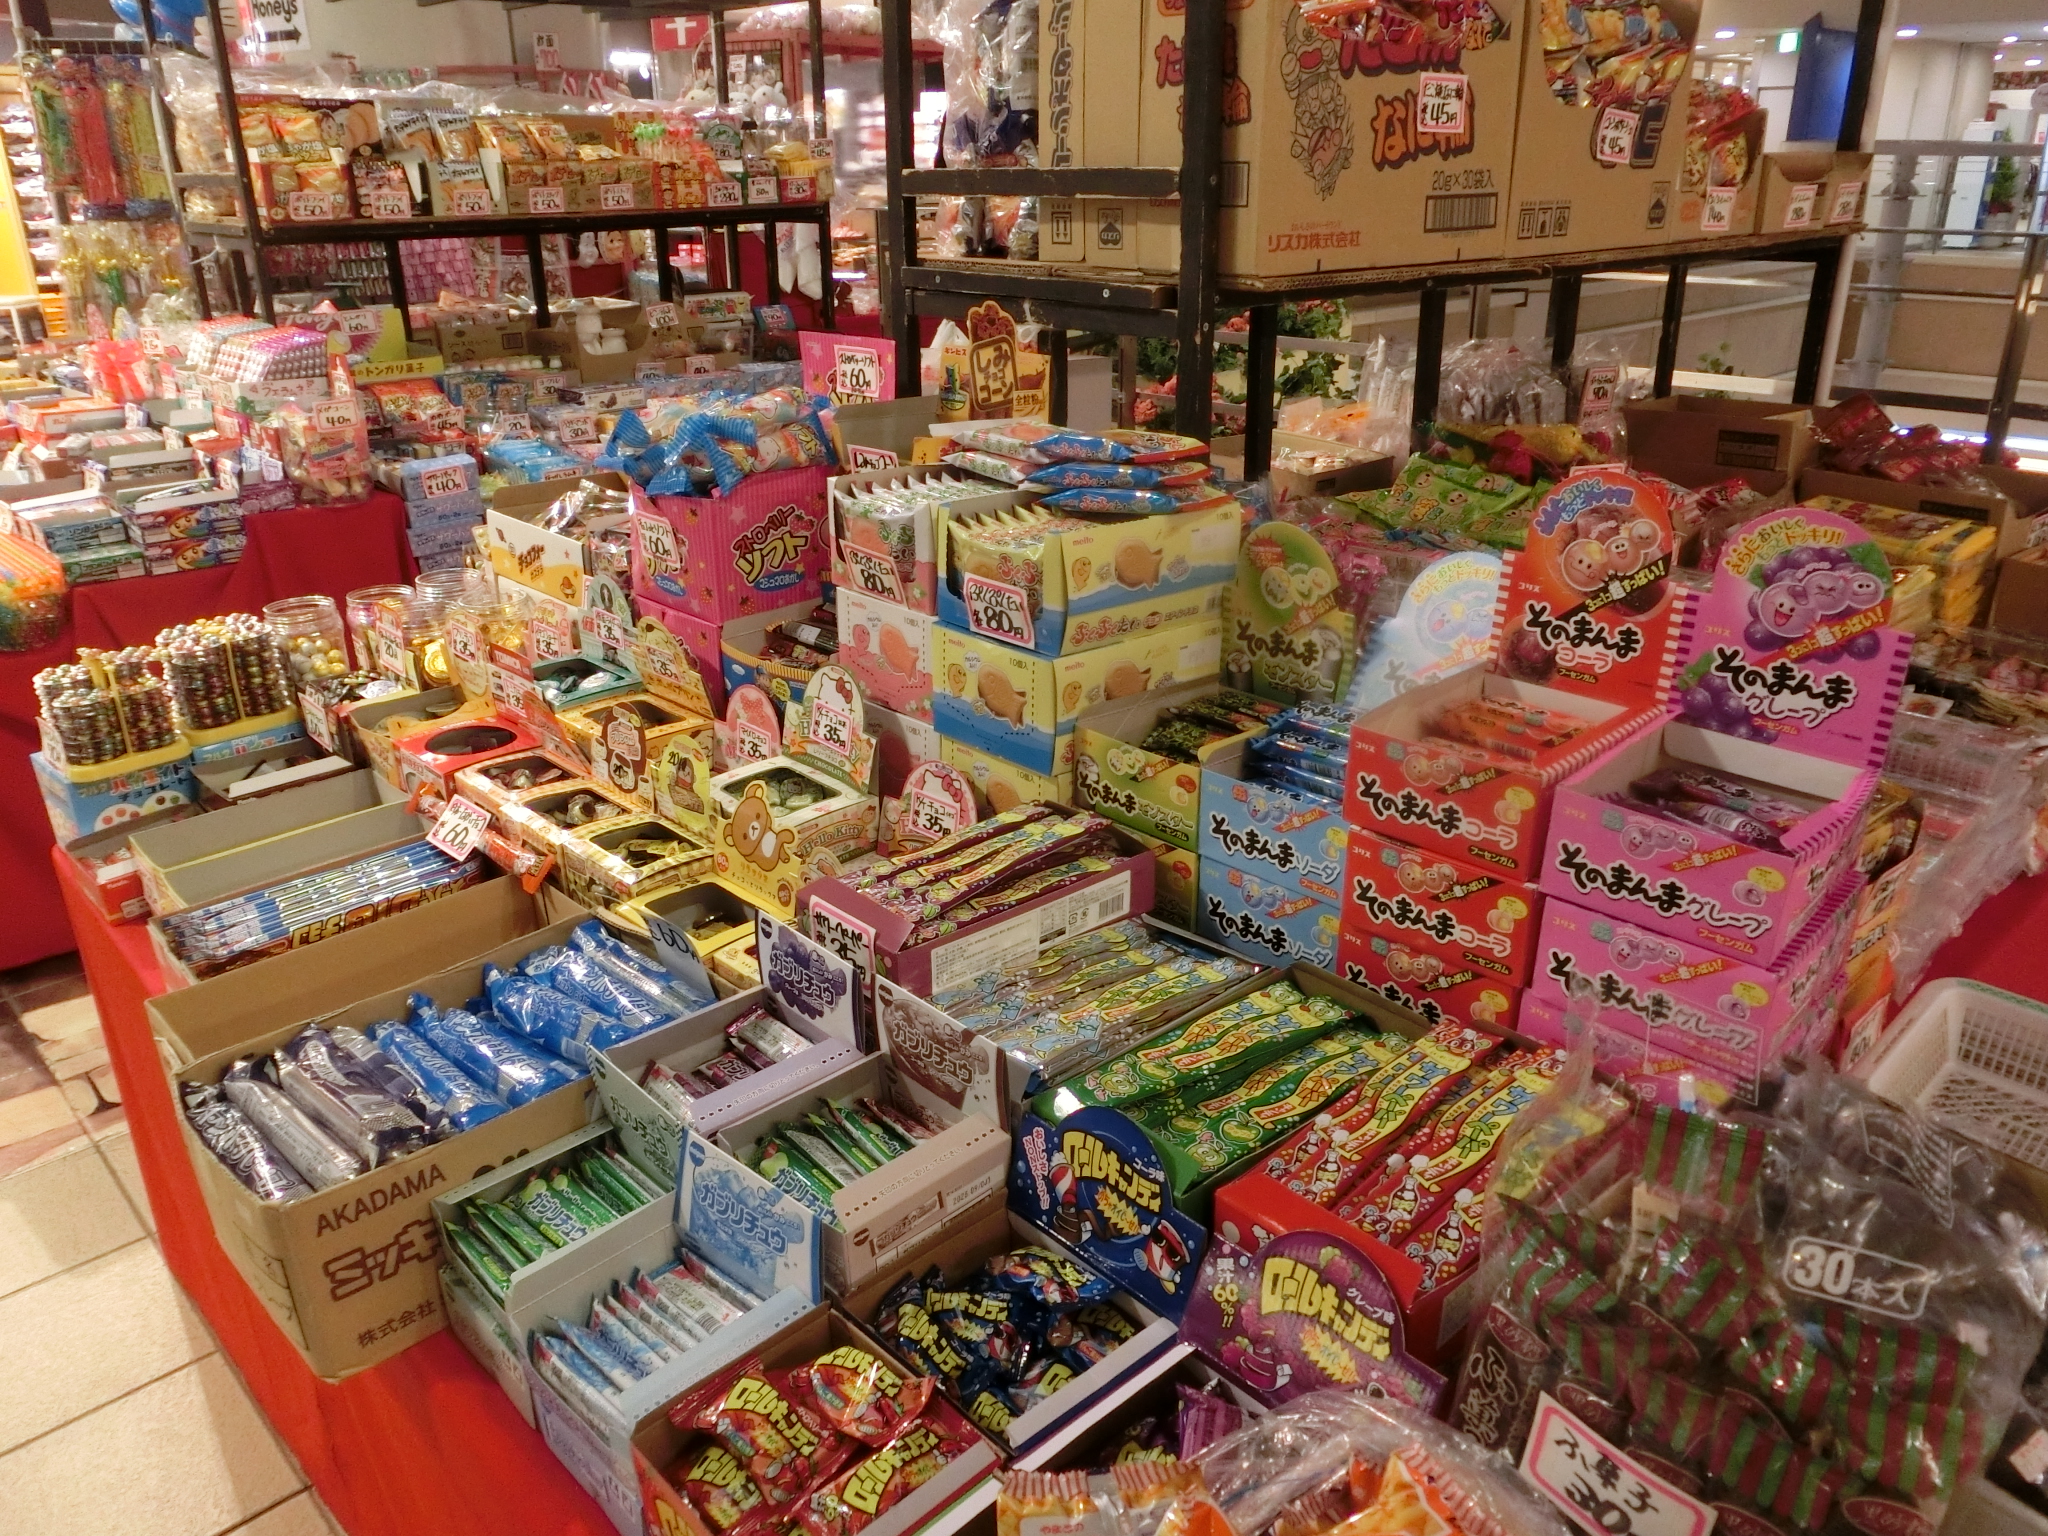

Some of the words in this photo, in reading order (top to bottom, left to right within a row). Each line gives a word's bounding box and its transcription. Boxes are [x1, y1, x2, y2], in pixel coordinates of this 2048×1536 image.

[1431, 103, 1459, 125] 45円
[1268, 231, 1361, 252] リスカ株式会社
[848, 366, 873, 390] 60円
[326, 414, 354, 427] 40円
[435, 479, 463, 493] 40円
[735, 533, 811, 586] ソフト
[861, 568, 899, 599] 80円
[982, 608, 1025, 639] 80円
[1524, 602, 1641, 658] そのまんま
[1713, 646, 1854, 709] そのまんま
[748, 740, 768, 761] 35円
[823, 723, 847, 750] 35円
[1078, 770, 1137, 815] そのまんま
[1358, 773, 1462, 836] そのまんま
[443, 823, 470, 852] 60円
[803, 831, 833, 856] Hello
[834, 824, 863, 839] Kitty
[922, 812, 952, 838] 35円
[1210, 813, 1296, 868] そのまんま
[1464, 820, 1516, 848] コーラ
[1559, 842, 1686, 913] そのまんま
[1208, 896, 1288, 953] そのまんま
[1356, 880, 1458, 940] そのまんま
[1459, 930, 1510, 956] コーラ
[771, 950, 836, 1008] ガブリチュウ
[893, 1019, 974, 1086] ガブリチュウ
[316, 1163, 446, 1238] AKADAMA
[699, 1183, 788, 1255] ガブリチュウ
[357, 1299, 437, 1349] 株式会社
